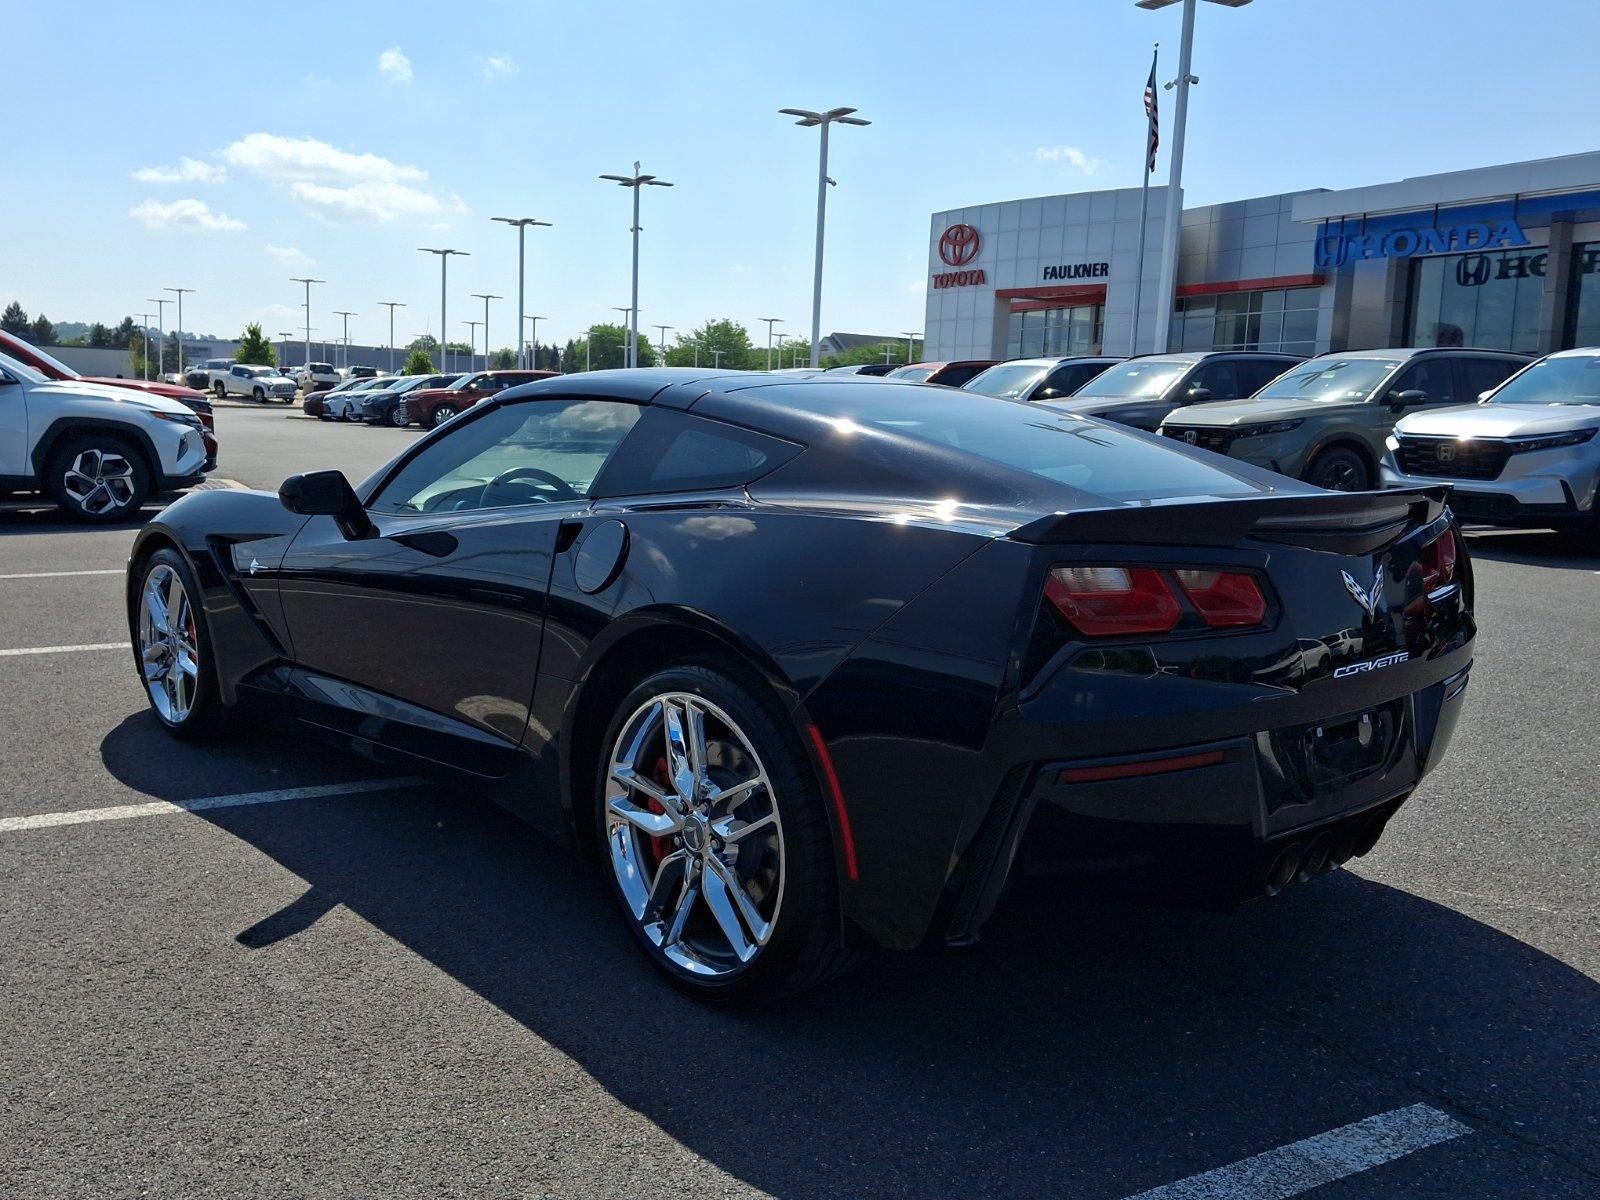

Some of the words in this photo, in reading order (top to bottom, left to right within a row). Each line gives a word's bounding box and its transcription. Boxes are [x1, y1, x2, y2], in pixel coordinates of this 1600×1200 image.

[1349, 220, 1531, 261] HONDA
[932, 269, 986, 289] TOYOTA
[1043, 262, 1109, 280] FAULKNER
[1333, 652, 1409, 678] CORVETTE
